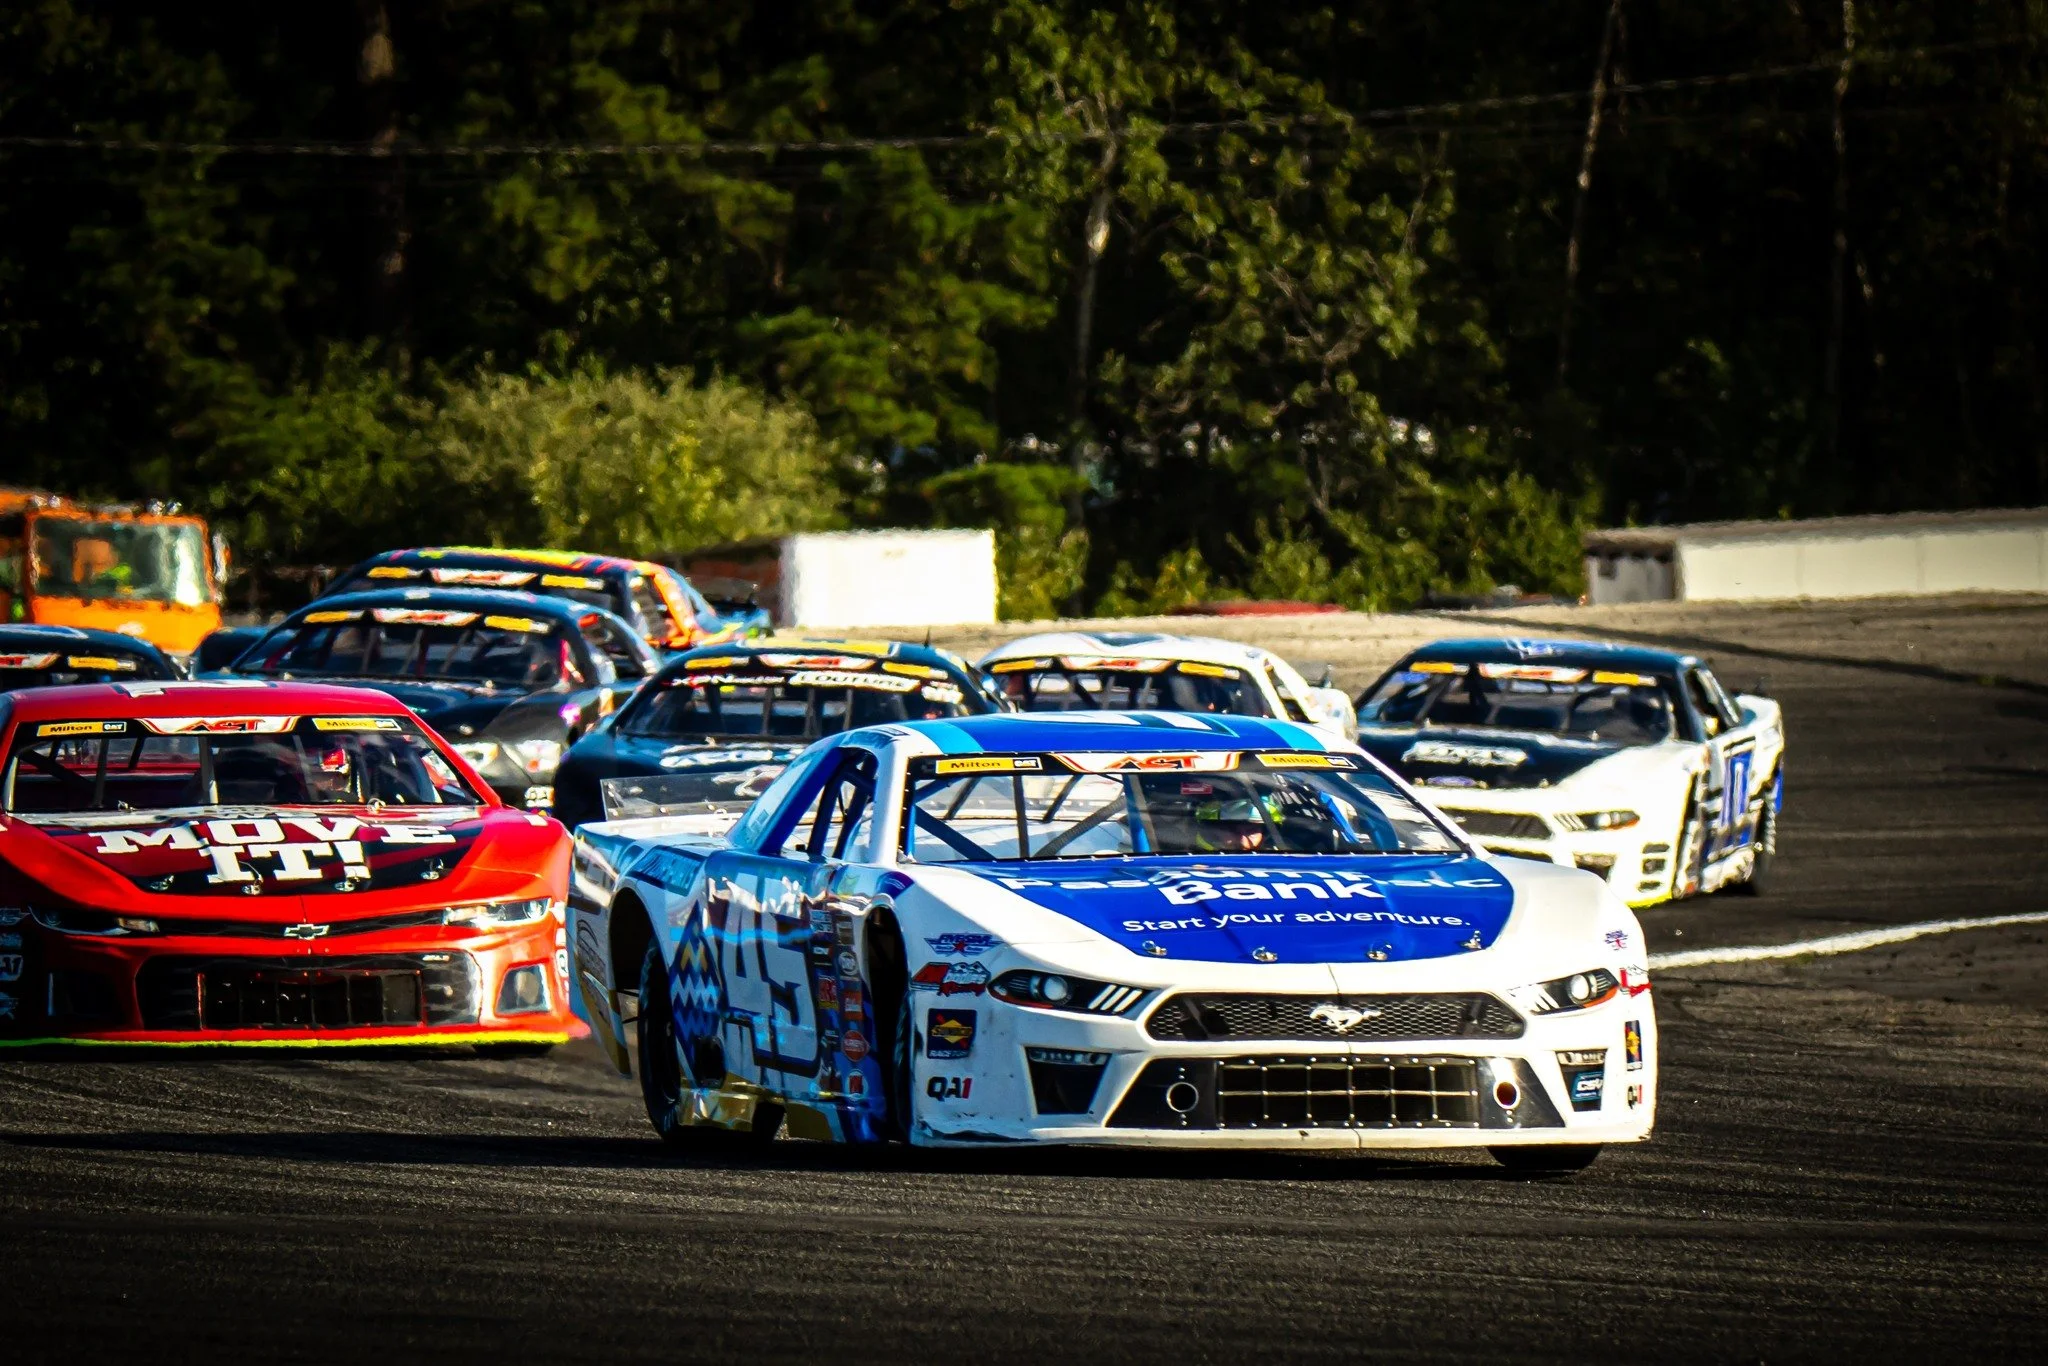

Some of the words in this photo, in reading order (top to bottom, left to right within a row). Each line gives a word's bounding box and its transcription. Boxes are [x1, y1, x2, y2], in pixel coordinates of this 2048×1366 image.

[50, 725, 93, 733] Milton
[325, 720, 367, 728] Milton
[950, 760, 1001, 770] Milton
[1273, 756, 1319, 765] Milton
[88, 817, 456, 854] MOVE
[199, 840, 371, 884] IT!
[1158, 879, 1387, 905] Bank
[1122, 917, 1206, 932] Start
[1211, 913, 1285, 929] your
[1294, 910, 1471, 926] adventure.
[927, 1076, 973, 1102] QA1
